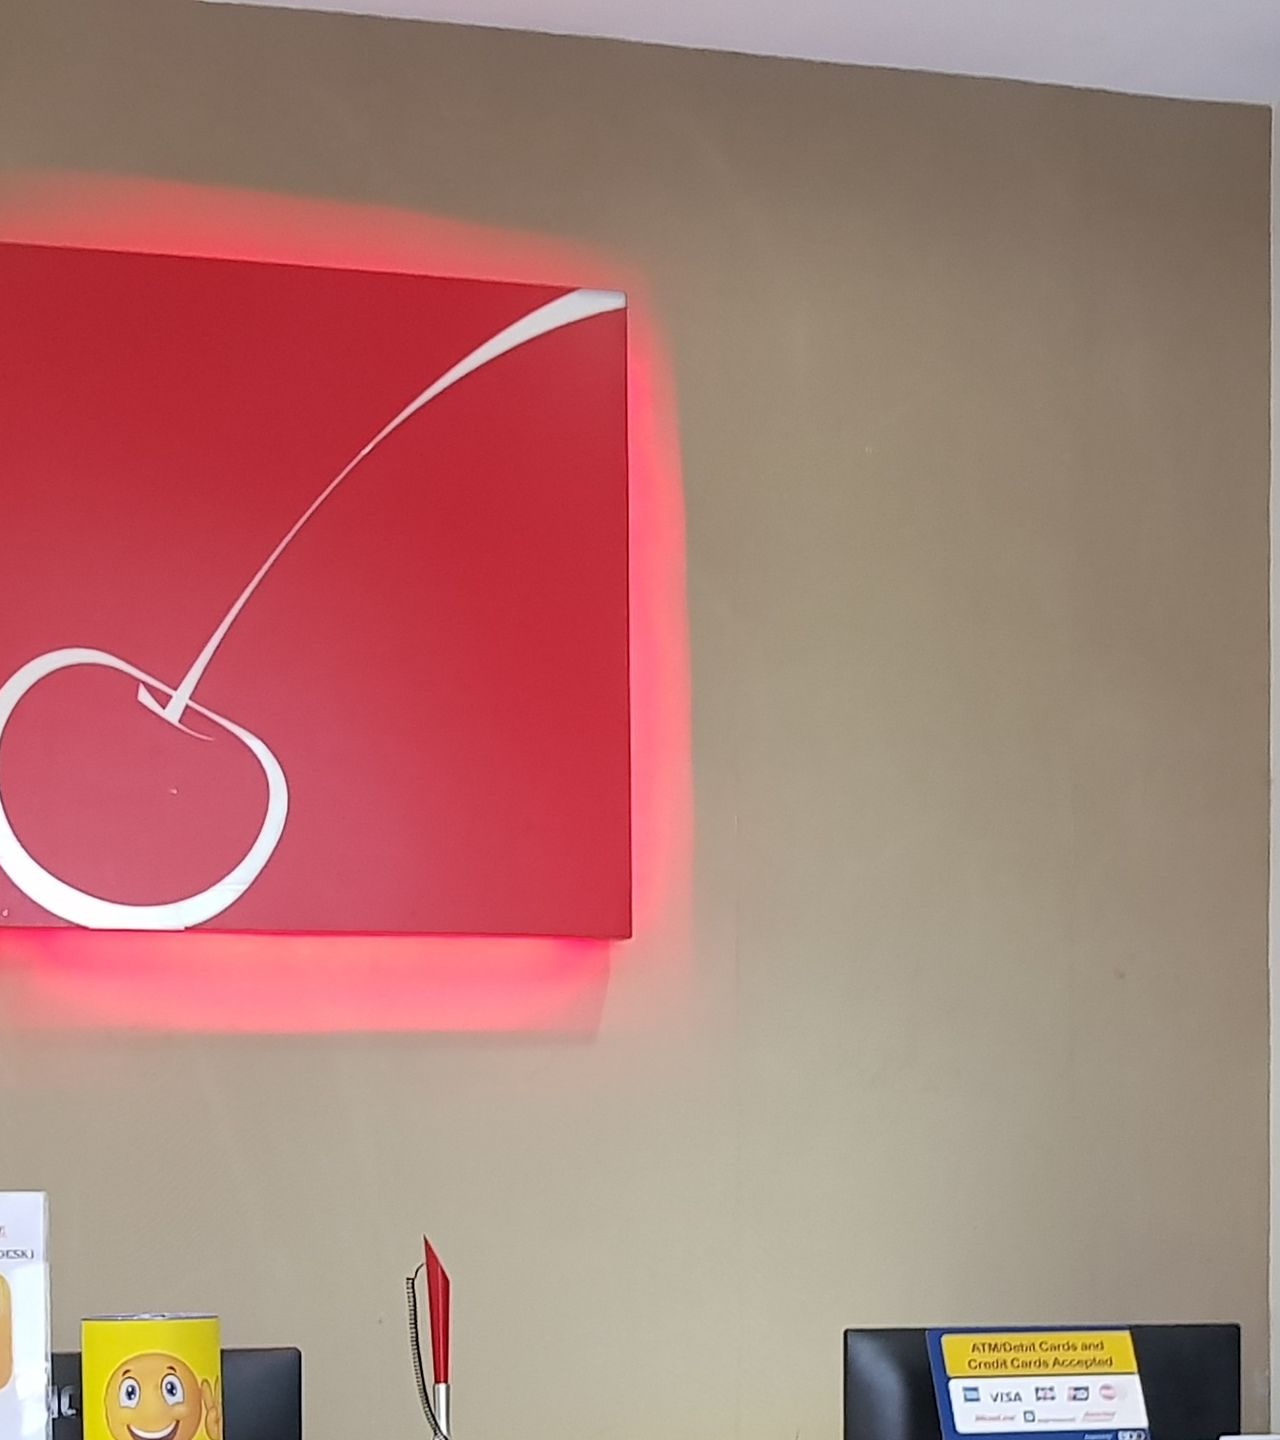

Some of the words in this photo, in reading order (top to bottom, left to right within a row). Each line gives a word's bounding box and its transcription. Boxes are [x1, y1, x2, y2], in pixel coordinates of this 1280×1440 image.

[971, 1342, 1036, 1354] ATM/Debit
[1039, 1341, 1078, 1353] Cards
[1081, 1340, 1105, 1352] and
[967, 1358, 1008, 1370] Credit
[1010, 1358, 1049, 1370] Cards
[1052, 1356, 1114, 1370] Accepted
[990, 1391, 1023, 1402] VISA
